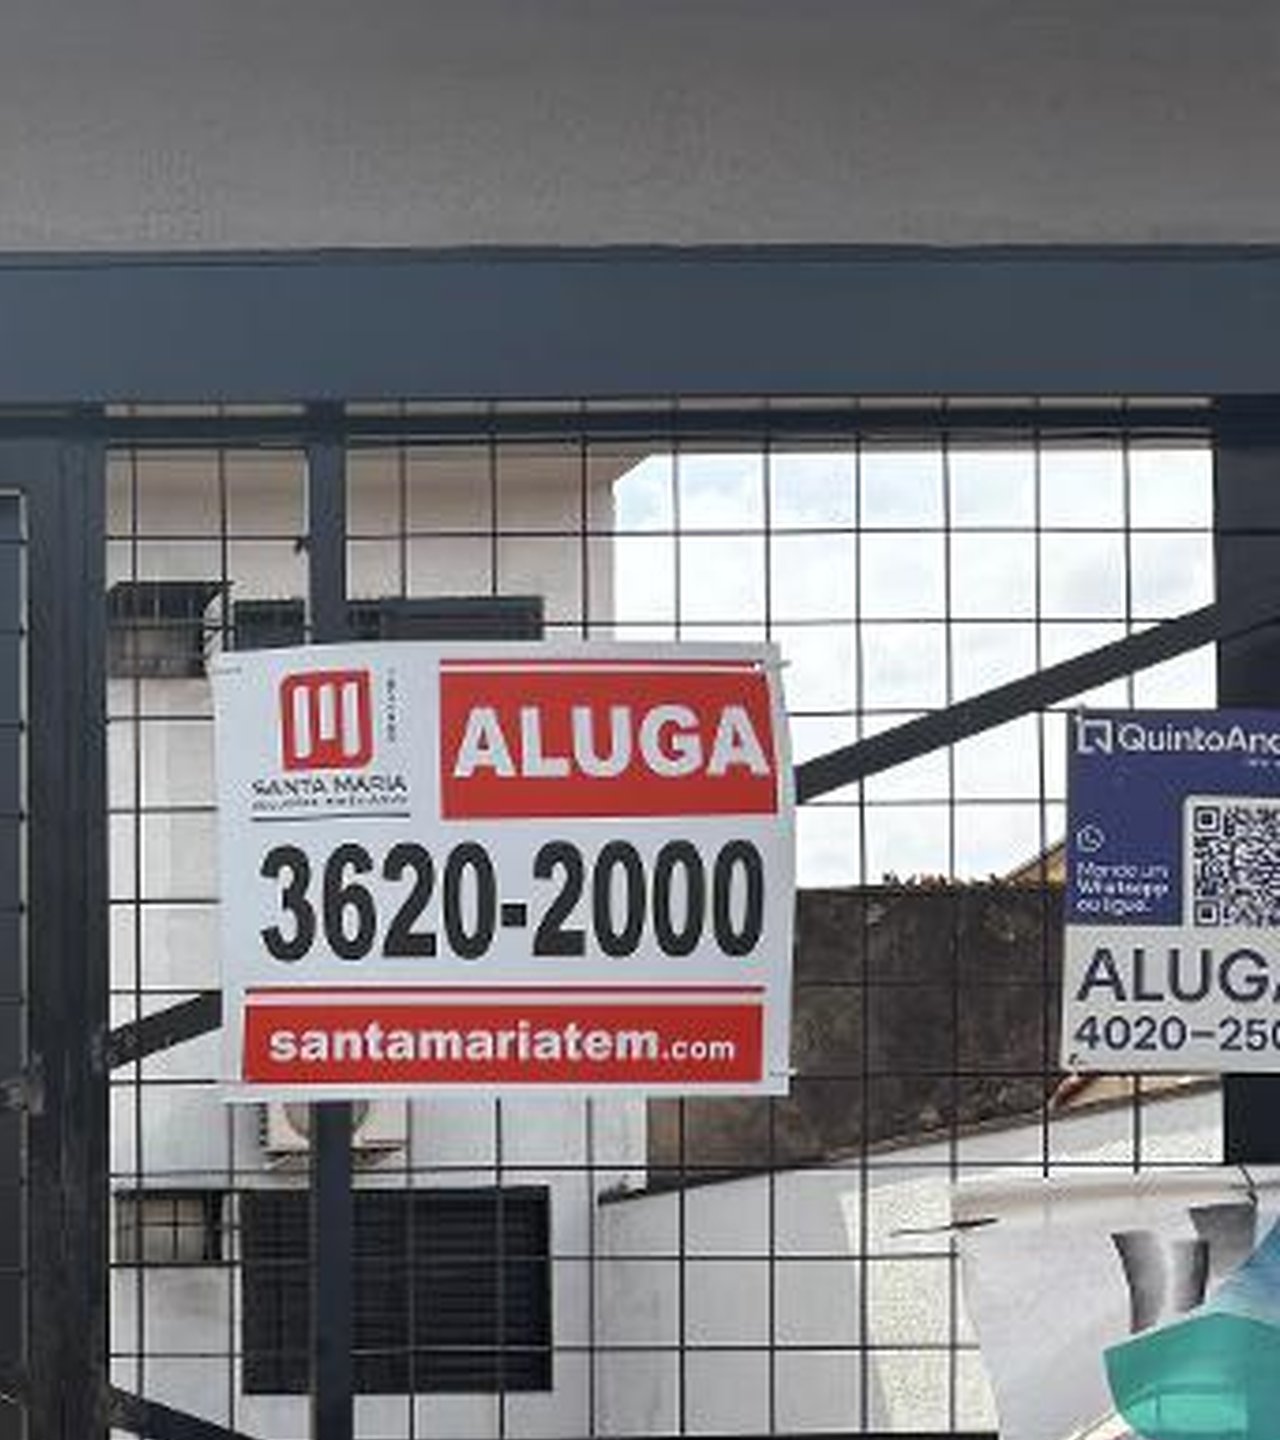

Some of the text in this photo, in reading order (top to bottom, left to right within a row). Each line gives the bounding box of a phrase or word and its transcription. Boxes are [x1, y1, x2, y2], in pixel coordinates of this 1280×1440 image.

[453, 704, 771, 778] ALUGA
[333, 774, 409, 793] MARIA
[260, 839, 766, 963] 3620-2000
[1076, 949, 1280, 1002] ALUG
[269, 1019, 736, 1063] santamariatem.com
